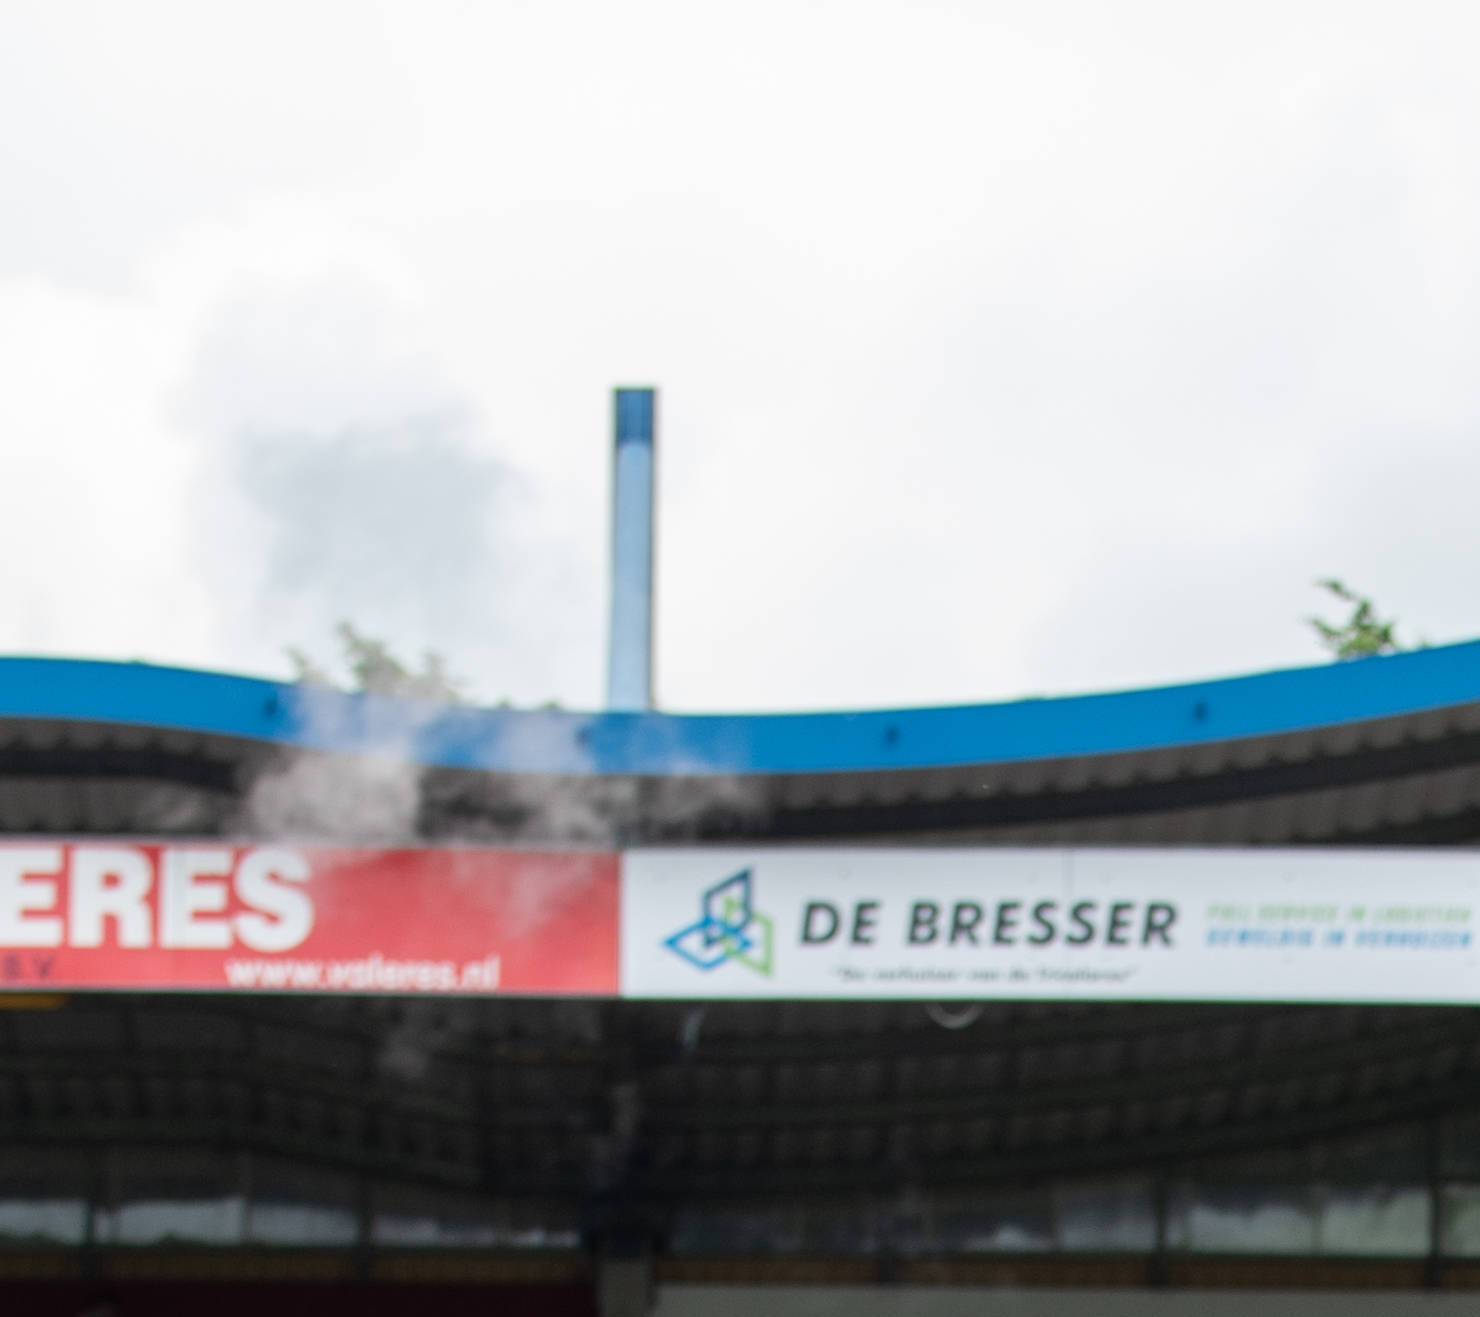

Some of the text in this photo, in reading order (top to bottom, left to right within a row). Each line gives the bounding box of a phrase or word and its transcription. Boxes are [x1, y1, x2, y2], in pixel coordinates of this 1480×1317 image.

[800, 901, 1181, 949] DE BRESSER
[224, 951, 502, 990] www.valeres.nl
